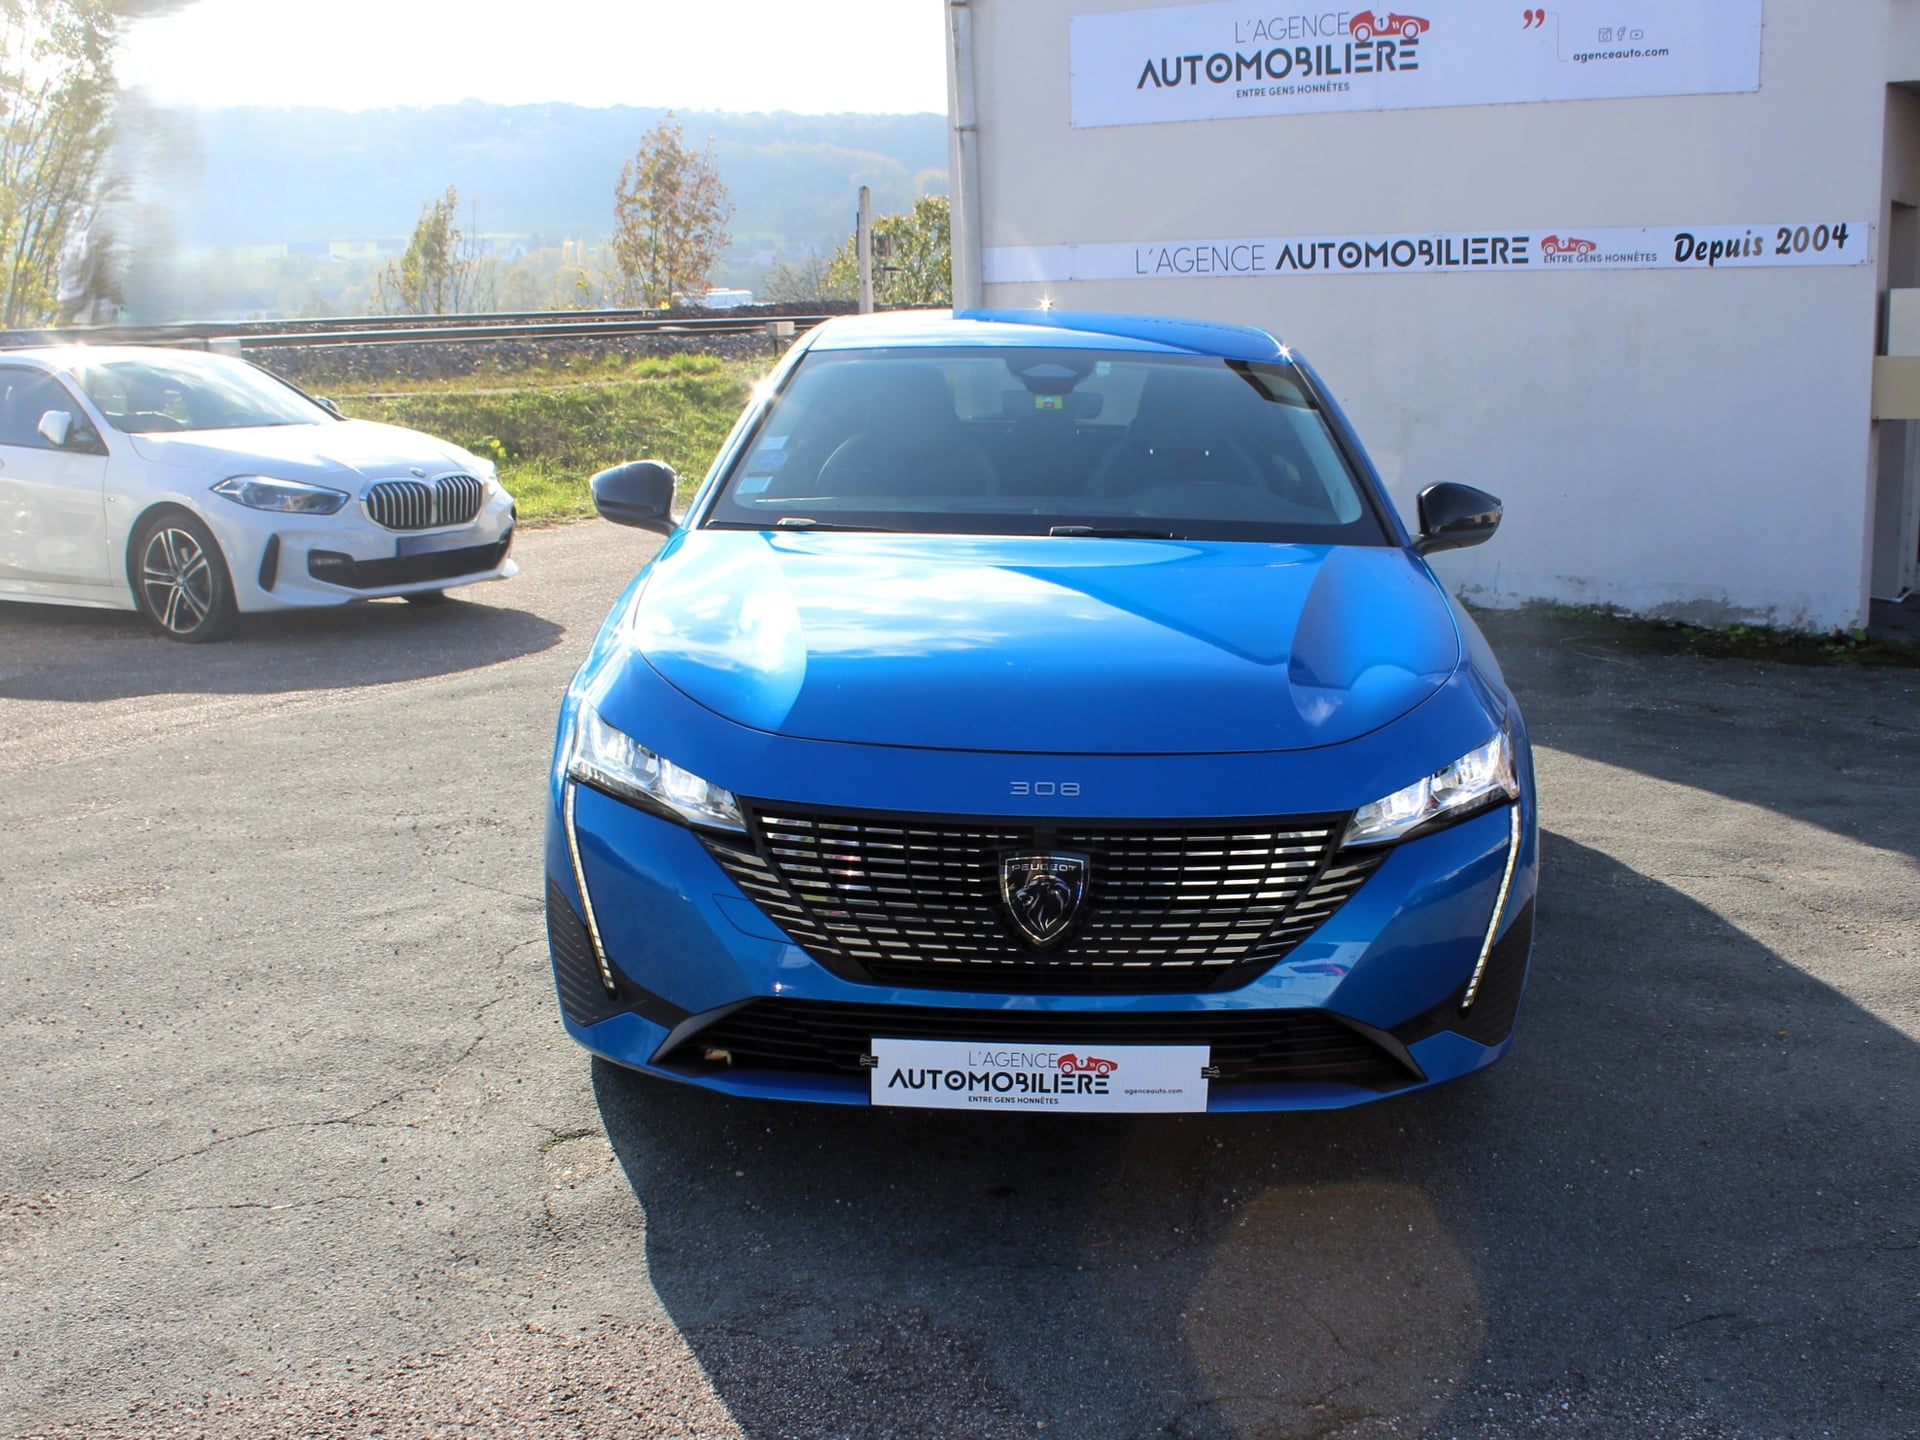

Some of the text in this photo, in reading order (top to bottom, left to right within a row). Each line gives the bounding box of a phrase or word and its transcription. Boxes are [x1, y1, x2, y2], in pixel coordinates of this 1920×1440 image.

[1234, 12, 1349, 43] L'AGENCE
[1573, 47, 1670, 63] agenceauto.com
[1236, 81, 1350, 98] ENTRE GENS HONNÊTES
[1674, 222, 1849, 266] Depuis 2004
[1136, 245, 1265, 274] L'AGENCE
[1544, 251, 1657, 264] ENTRE GENS HONNÊTES
[1010, 781, 1080, 796] 308
[1011, 863, 1077, 872] PEUGEOT
[968, 1052, 1058, 1069] L'AGENCE
[1124, 1087, 1184, 1096] agenceauto.com
[968, 1096, 1059, 1105] ENTRE GENS HONNÊTES
